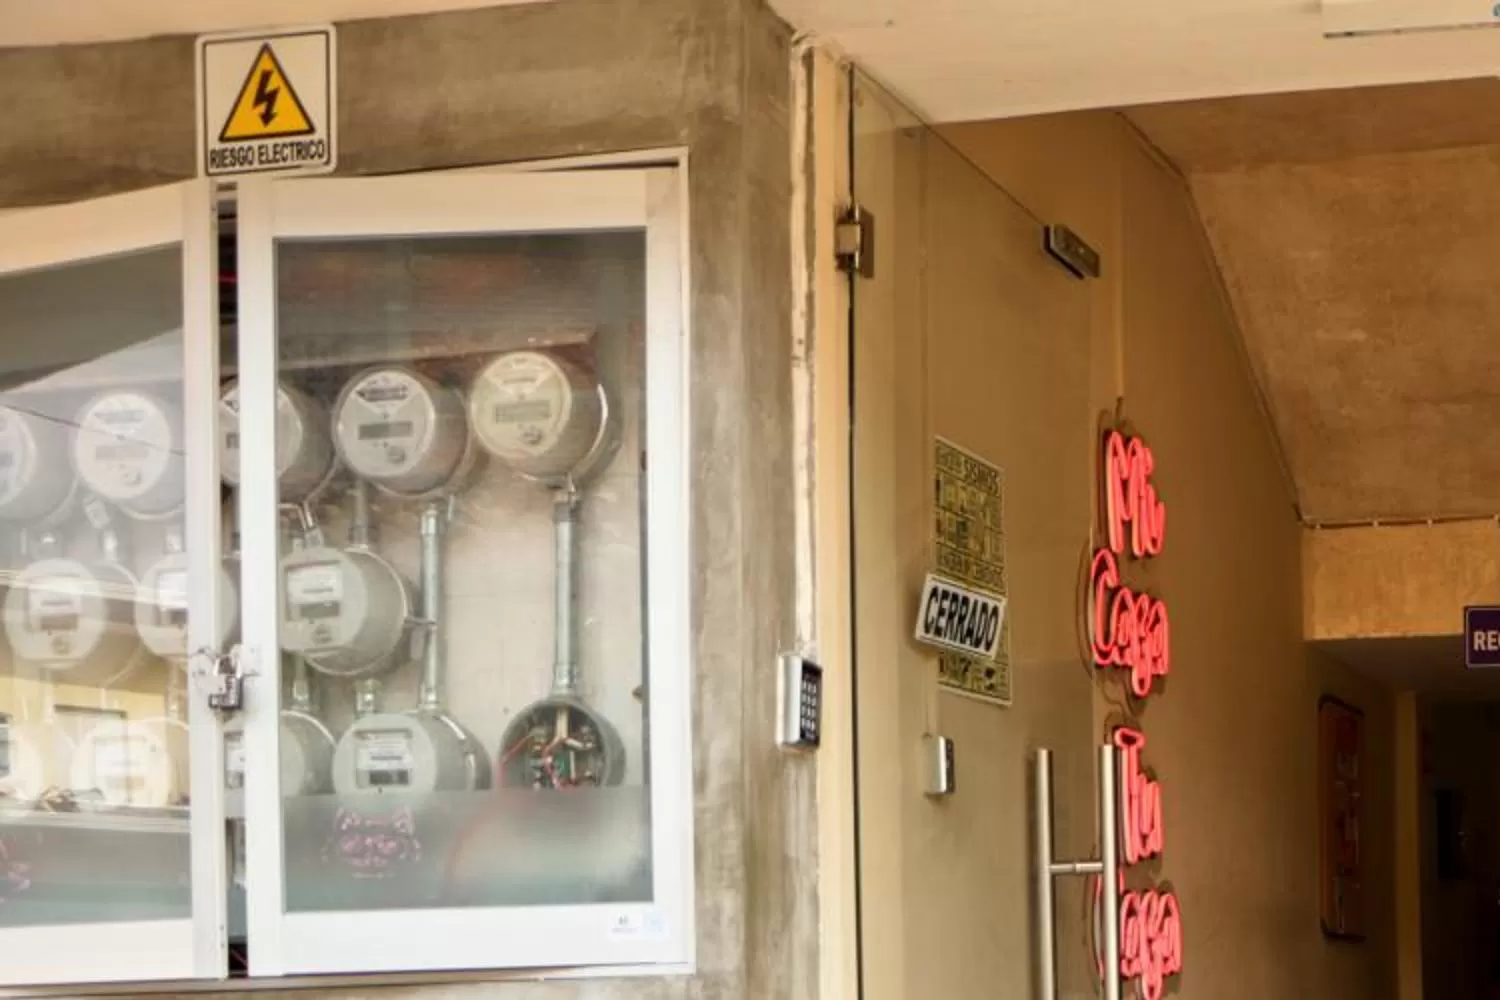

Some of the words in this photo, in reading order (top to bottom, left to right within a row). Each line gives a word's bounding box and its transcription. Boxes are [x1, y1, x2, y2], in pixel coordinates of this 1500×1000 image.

[210, 145, 255, 169] RIESGO
[258, 139, 325, 165] ELECTRICO
[924, 585, 999, 652] CERRADO
[1091, 548, 1169, 697] Casa
